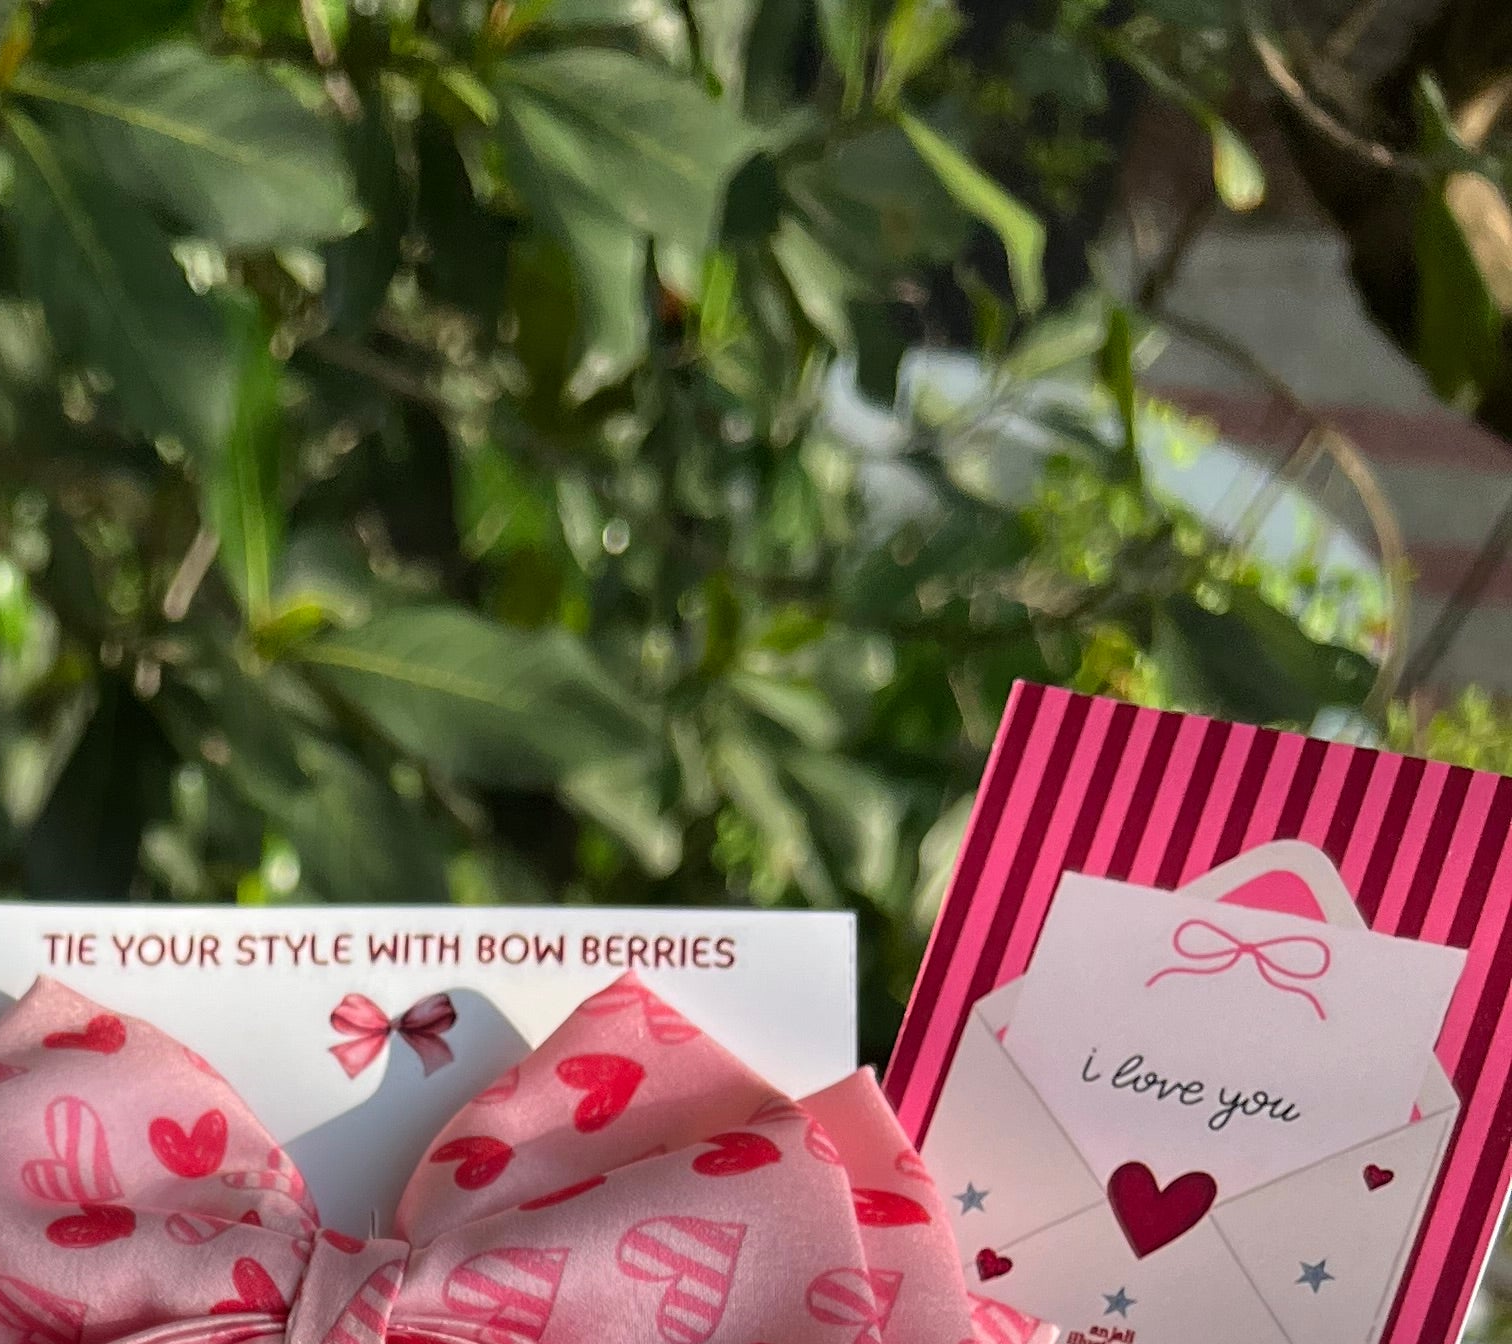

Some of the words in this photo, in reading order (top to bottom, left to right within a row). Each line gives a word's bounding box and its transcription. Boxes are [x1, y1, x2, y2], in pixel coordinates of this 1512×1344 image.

[43, 933, 96, 966] TIE
[112, 934, 221, 967] YOUR
[235, 934, 354, 966] STYLE
[368, 933, 460, 965] WITH
[478, 934, 565, 965] BOW
[582, 935, 736, 969] BERRIES
[1082, 1048, 1101, 1082] i
[1111, 1054, 1205, 1105] love
[1208, 1086, 1301, 1131] you
